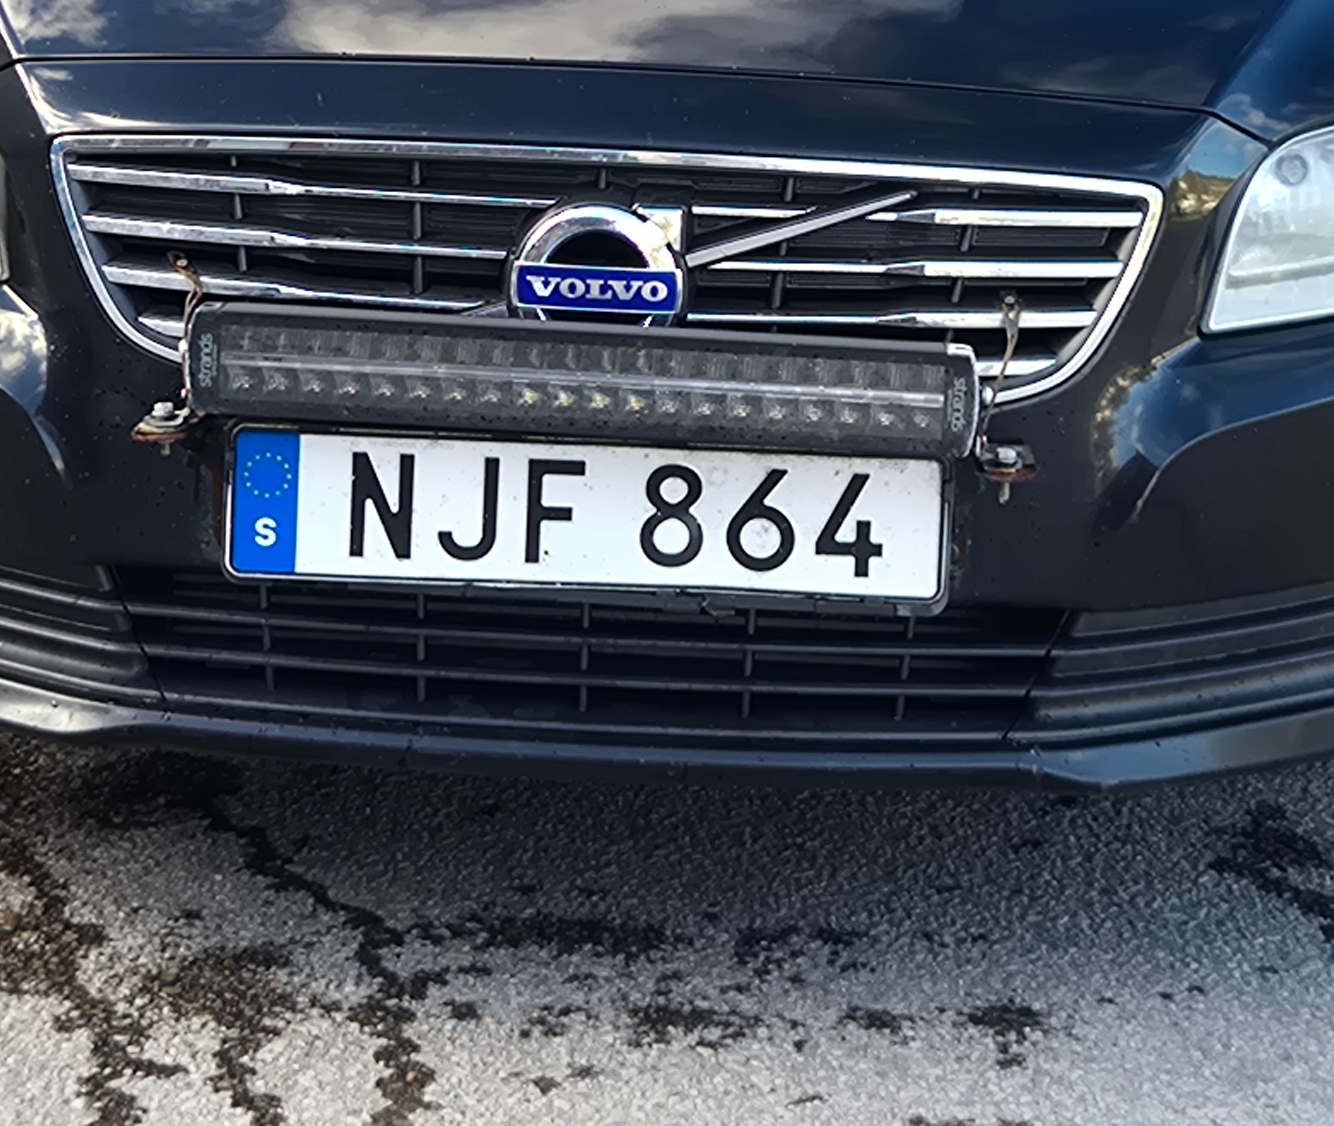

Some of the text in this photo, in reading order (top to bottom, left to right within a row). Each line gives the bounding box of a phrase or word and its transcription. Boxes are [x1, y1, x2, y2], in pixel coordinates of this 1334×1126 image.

[526, 275, 668, 302] VOLVO
[349, 451, 883, 578] NJF 864
[254, 517, 278, 547] S
